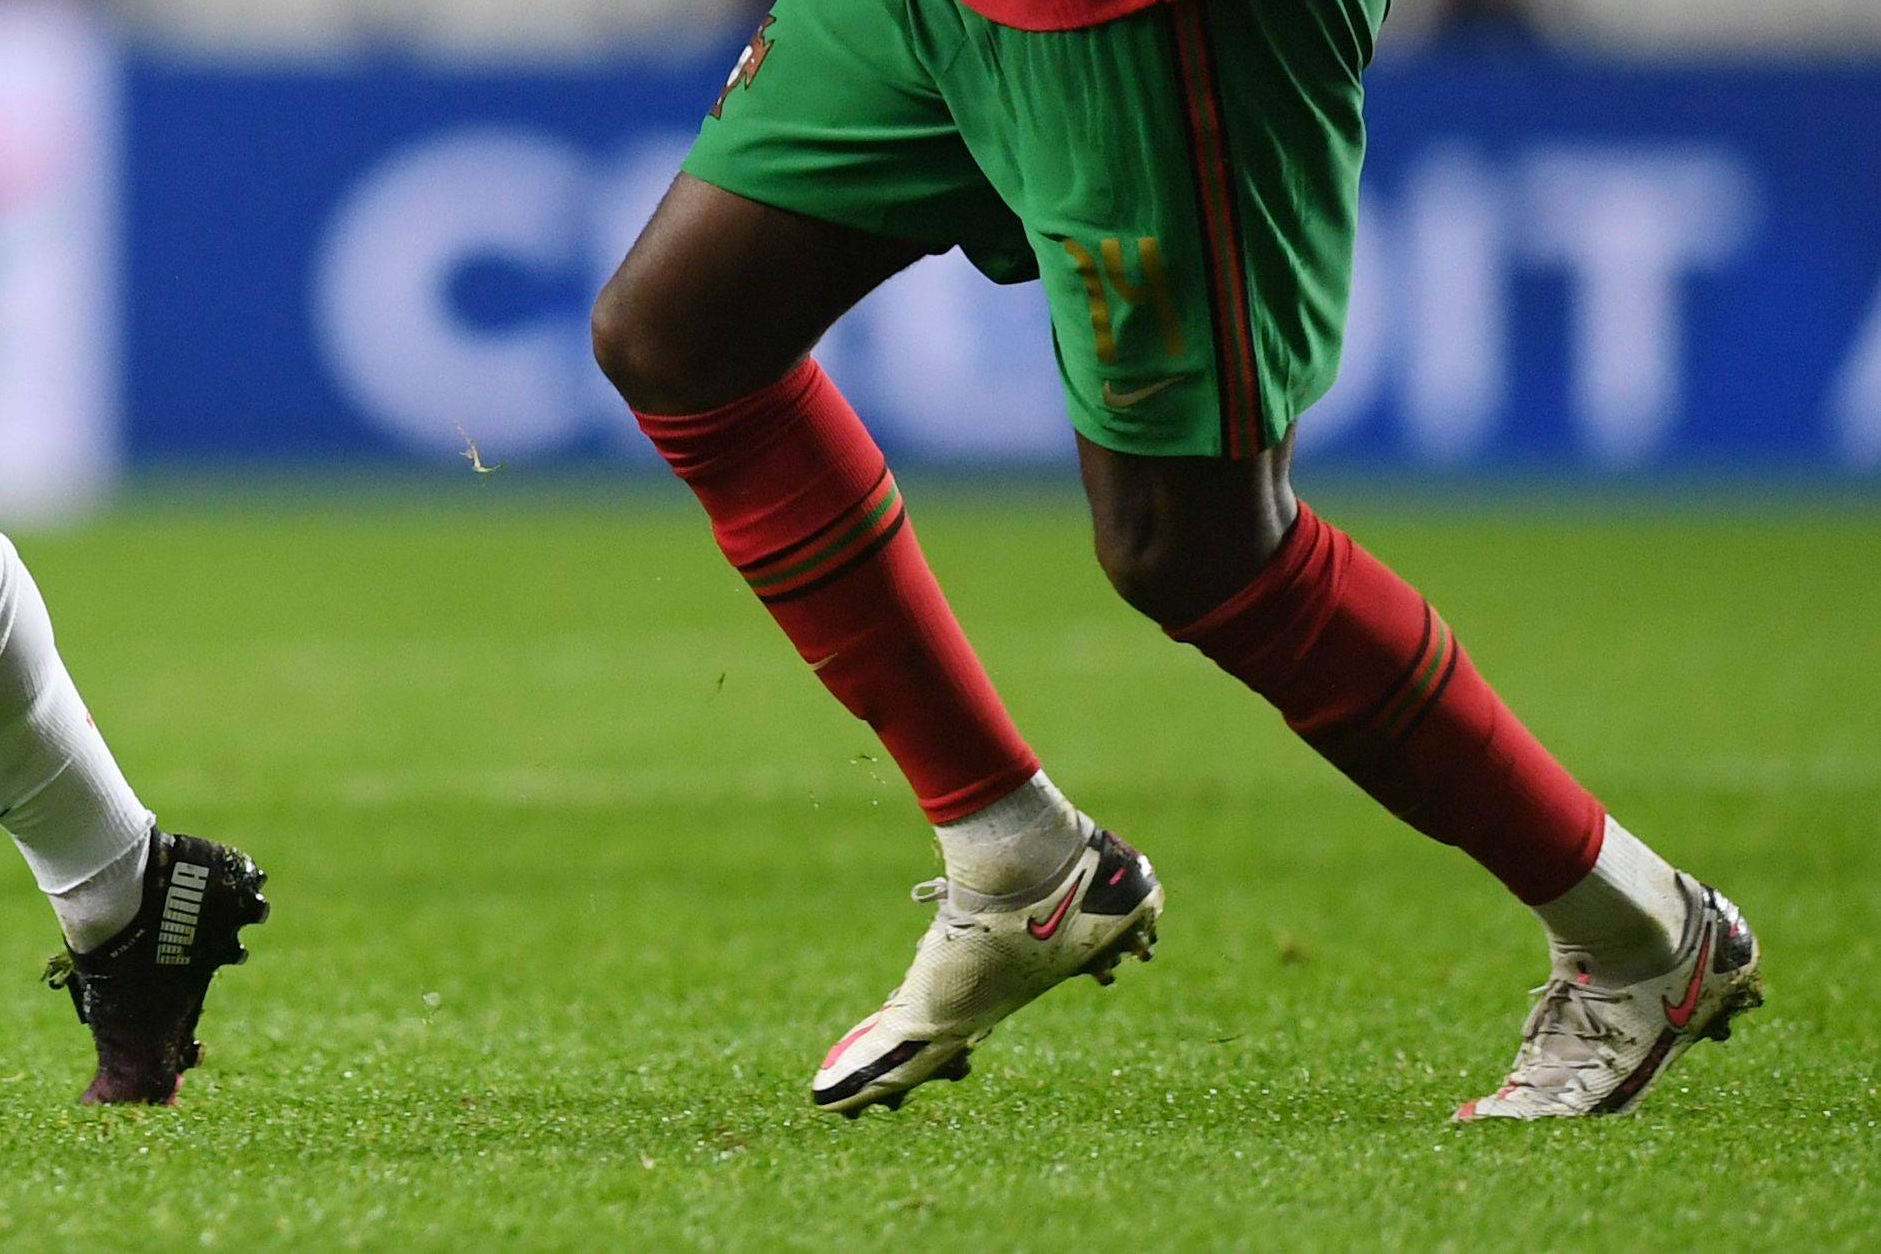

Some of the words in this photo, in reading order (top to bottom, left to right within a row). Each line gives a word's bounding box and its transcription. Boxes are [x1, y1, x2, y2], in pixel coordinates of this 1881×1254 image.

[314, 131, 1759, 456] CIT
[1064, 236, 1185, 366] 14
[155, 861, 211, 965] PUMA
